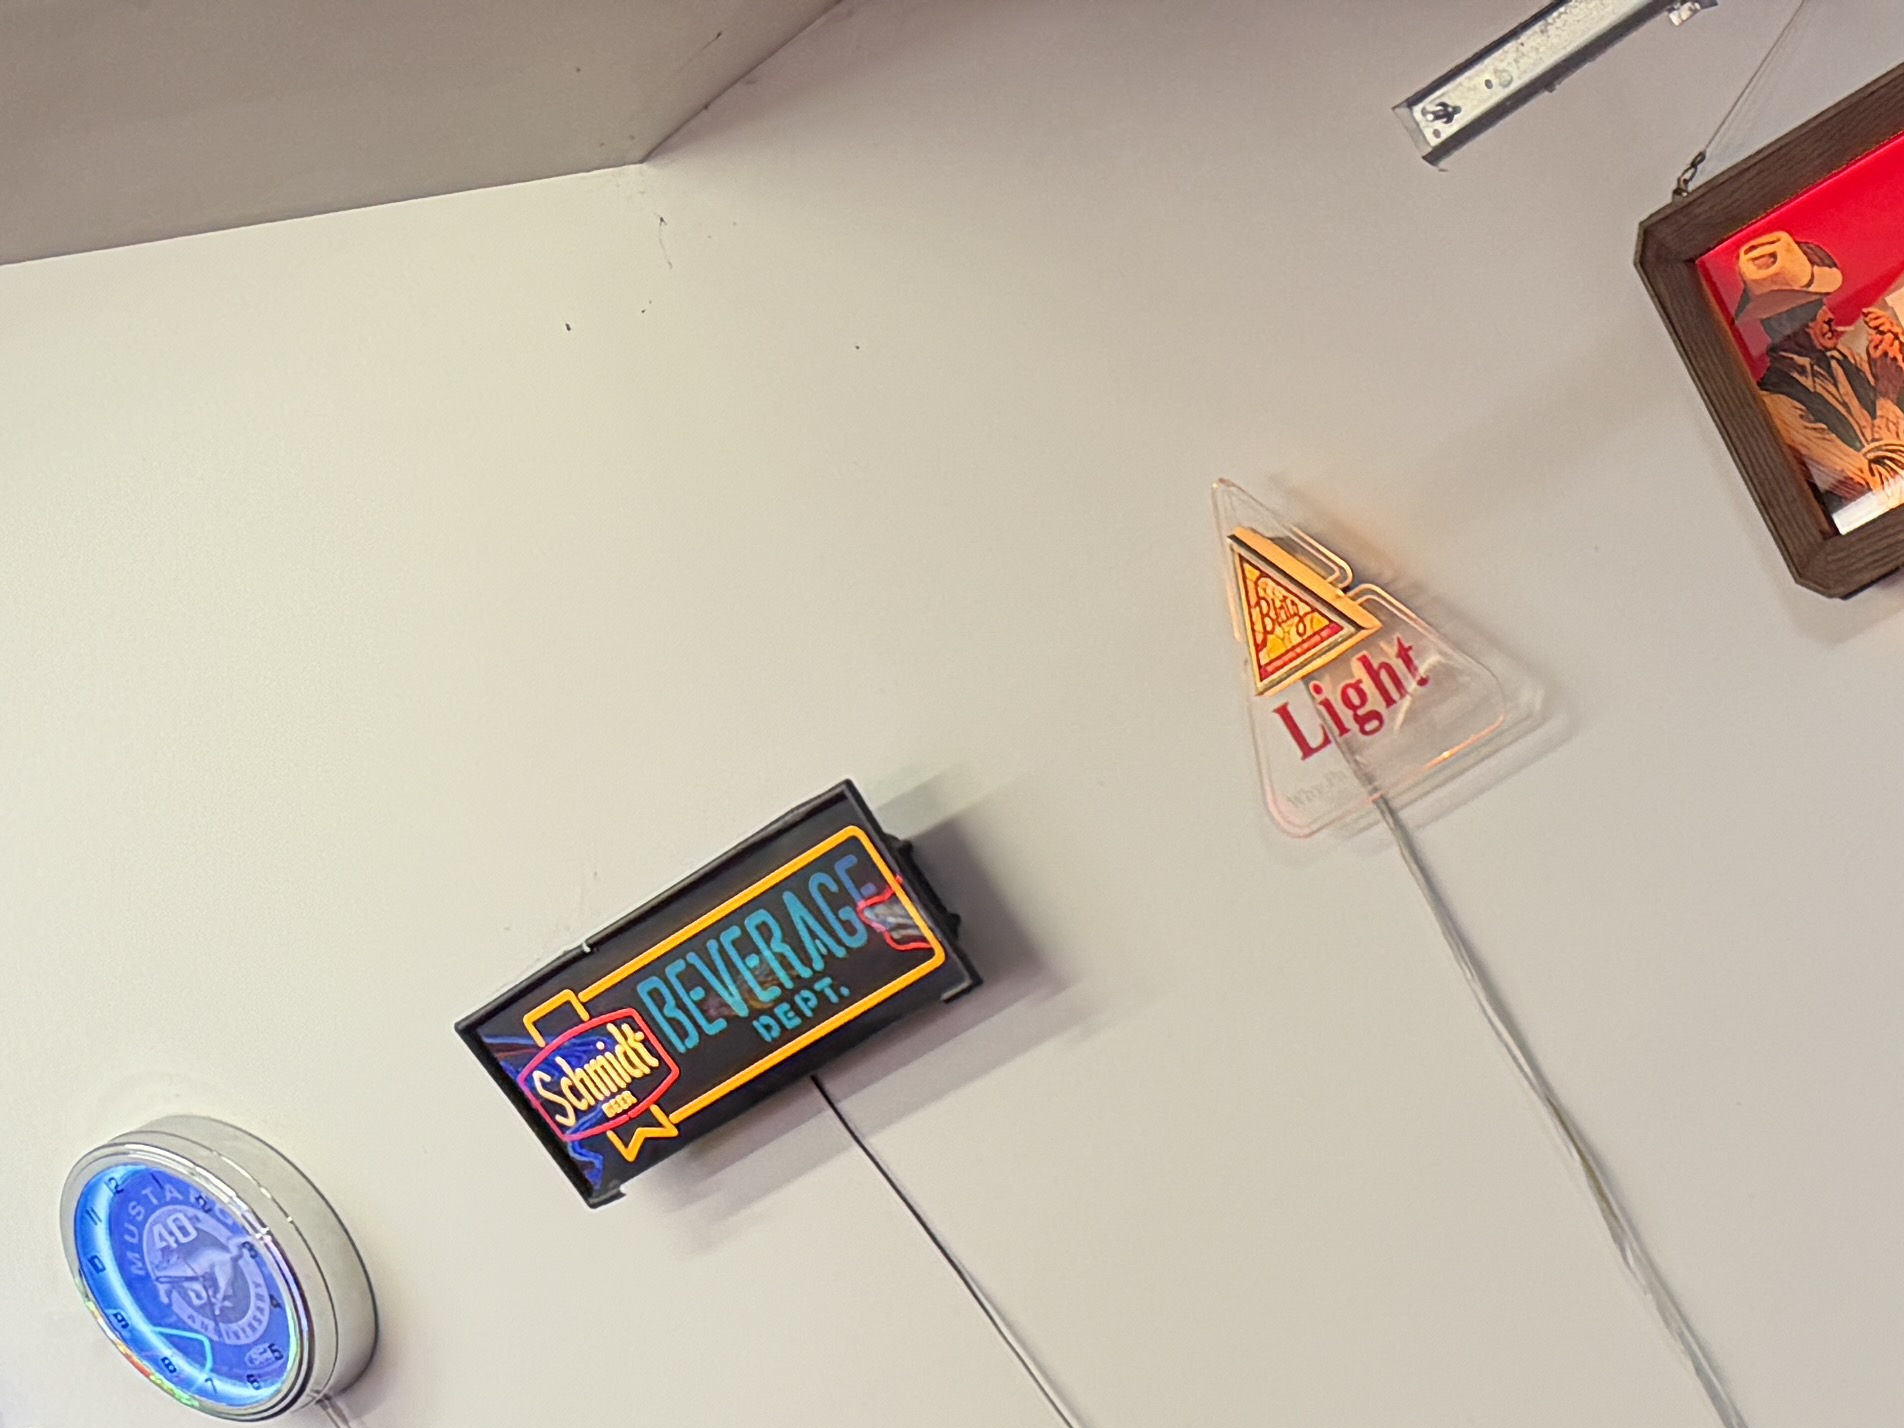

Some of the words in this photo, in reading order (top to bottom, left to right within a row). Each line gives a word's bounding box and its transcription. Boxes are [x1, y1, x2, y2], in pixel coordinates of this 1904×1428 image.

[1271, 634, 1431, 762] Light
[636, 853, 876, 1055] BEVERAGE
[752, 975, 850, 1043] DEPT.
[531, 1021, 660, 1127] Schmidt
[601, 1090, 638, 1118] BEER
[194, 1194, 212, 1214] 2
[153, 1212, 198, 1249] 40
[161, 1356, 177, 1374] 8
[268, 1343, 284, 1361] 5
[204, 1377, 218, 1394] 7
[246, 1373, 261, 1390] 6
